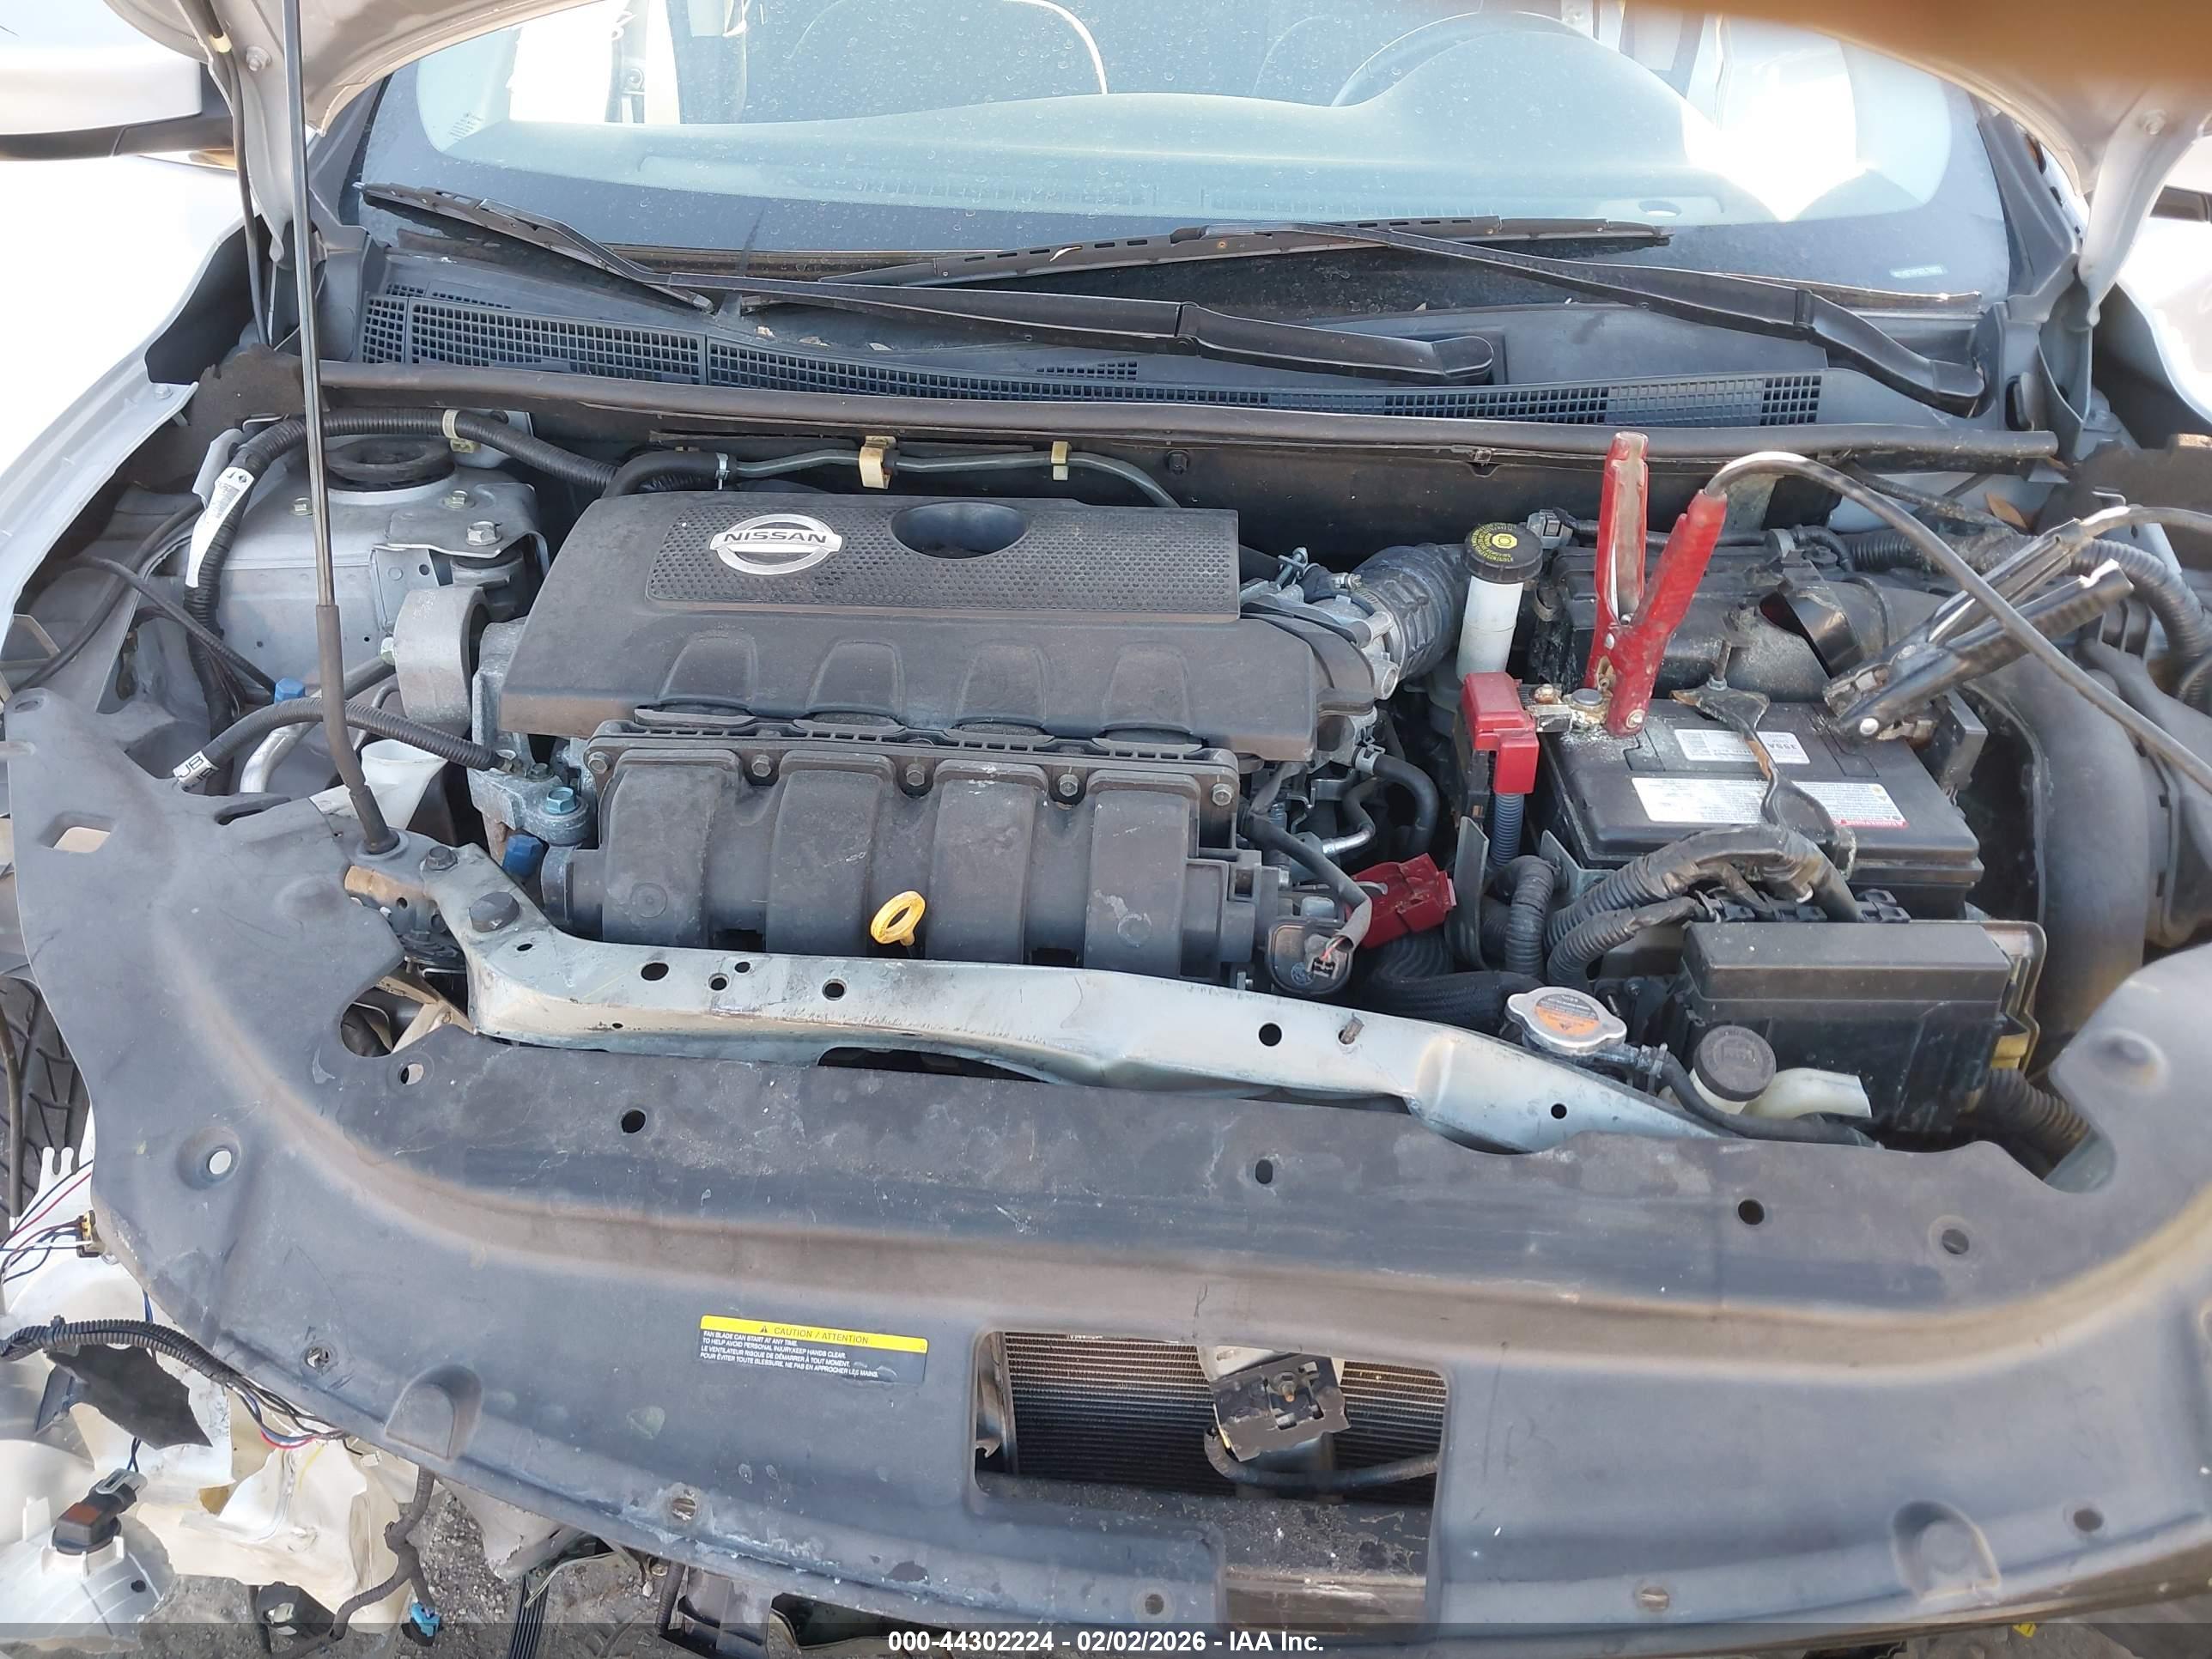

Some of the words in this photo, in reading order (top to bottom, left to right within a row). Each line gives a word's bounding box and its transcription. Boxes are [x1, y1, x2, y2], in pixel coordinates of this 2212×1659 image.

[724, 532, 827, 543] NISSAN
[774, 1328, 812, 1339] CAUTION
[821, 1332, 869, 1344] ATTENTION
[708, 1346, 744, 1356] VENTILATEUR
[744, 1350, 765, 1358] RISQUE
[775, 1352, 805, 1362] DÉMARRER
[744, 1342, 772, 1351] PERSONAL
[717, 1353, 736, 1362] ÉVITER
[814, 1364, 848, 1374] APPROCHER
